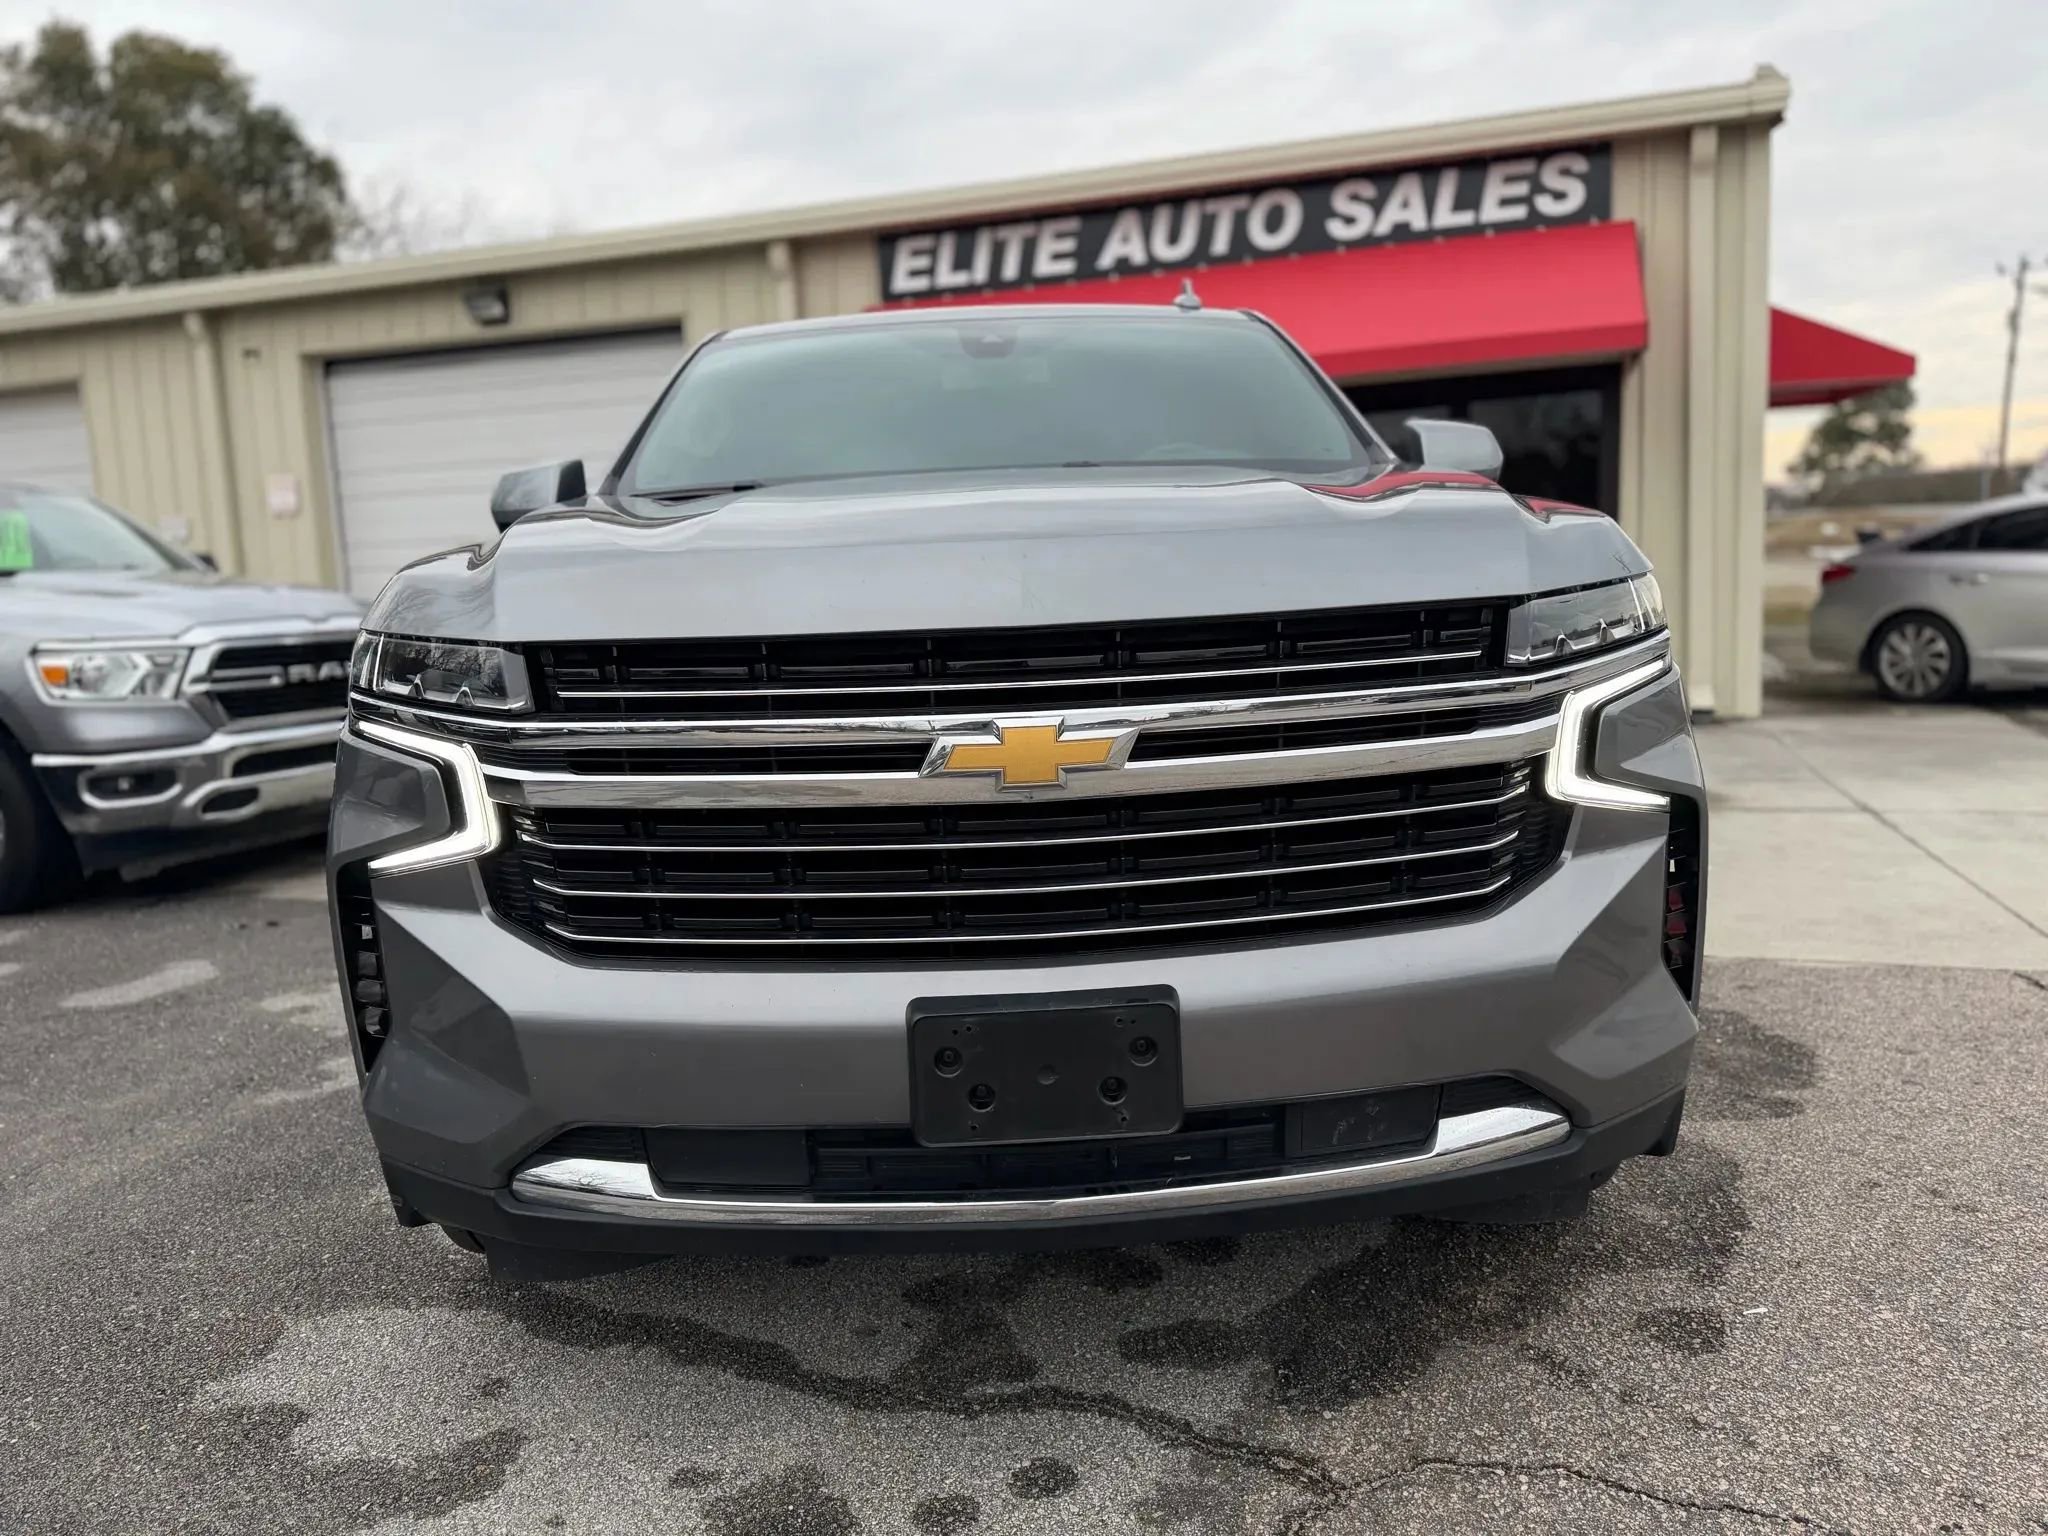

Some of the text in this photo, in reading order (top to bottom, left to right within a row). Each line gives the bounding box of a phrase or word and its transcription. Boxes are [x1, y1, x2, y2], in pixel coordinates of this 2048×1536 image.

[889, 152, 1590, 294] ELITE AUTO SALES
